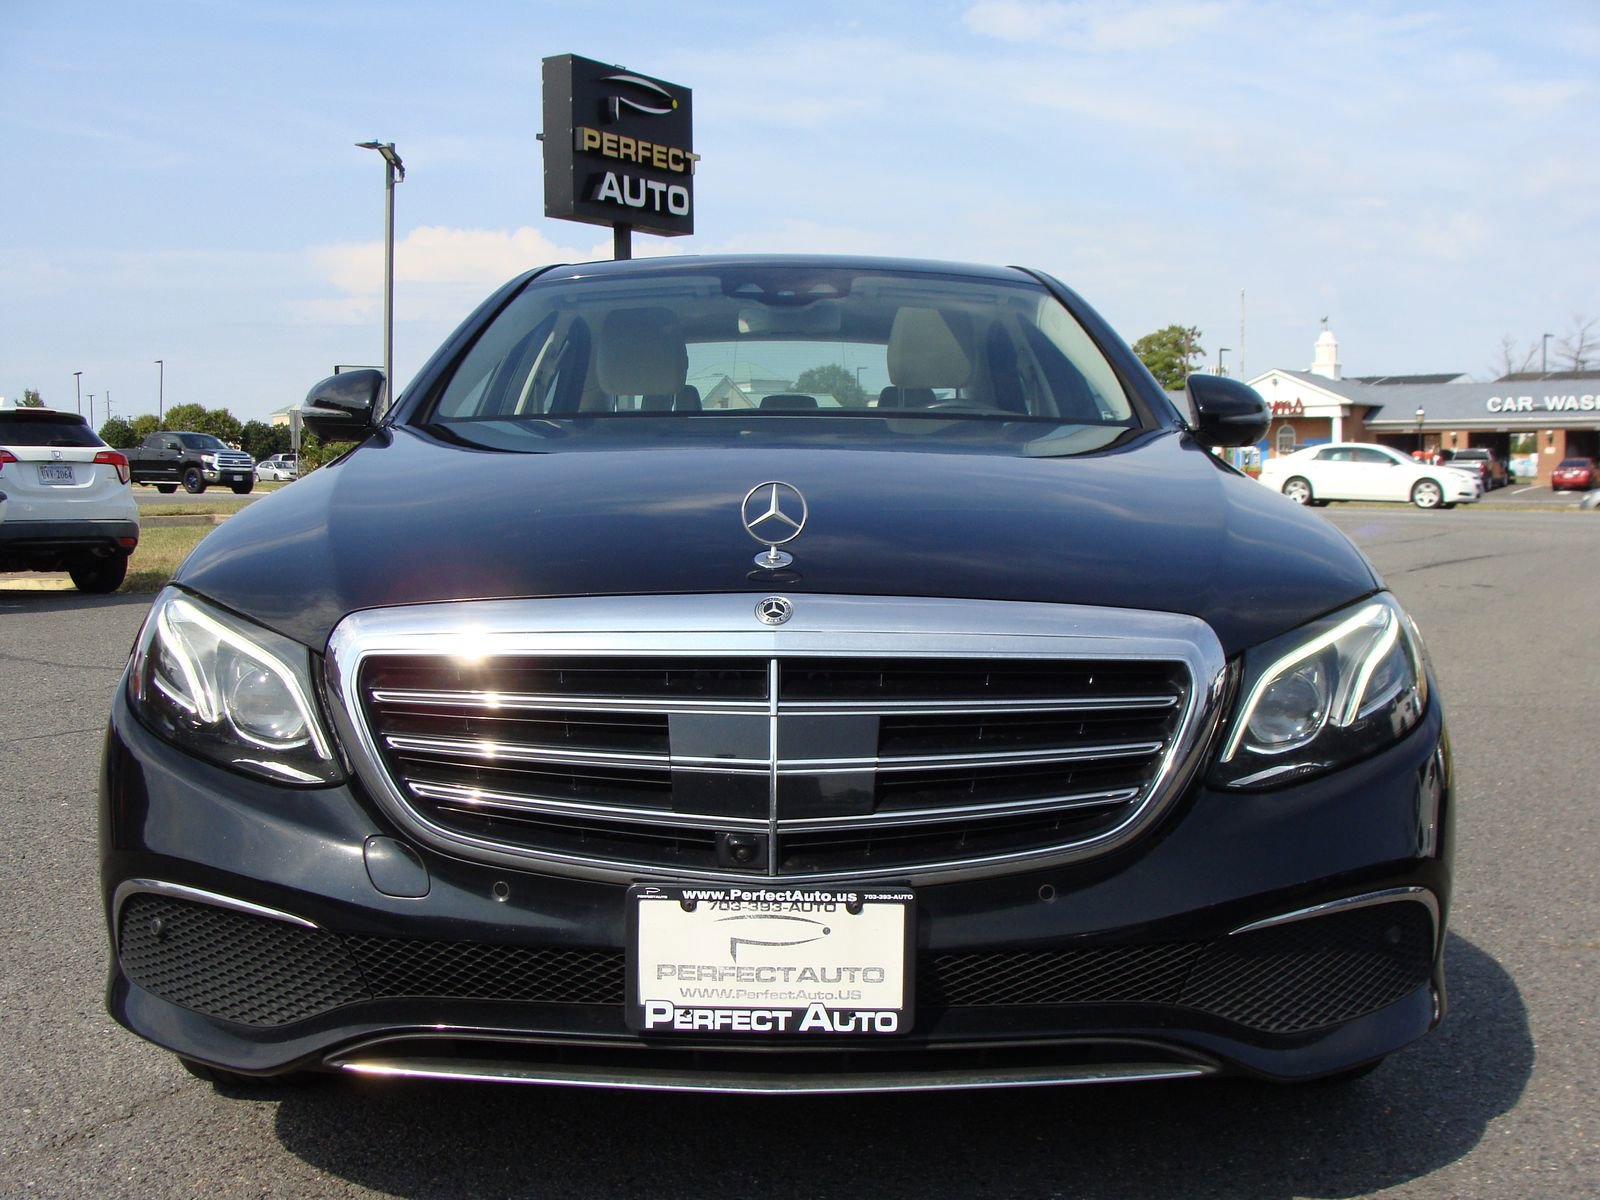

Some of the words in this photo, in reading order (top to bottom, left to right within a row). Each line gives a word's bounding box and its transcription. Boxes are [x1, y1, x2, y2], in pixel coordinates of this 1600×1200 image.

[583, 127, 700, 175] PERFECT
[597, 171, 689, 216] AUTO
[1486, 396, 1533, 412] CAR
[682, 889, 858, 902] www.PerfectAuto.us
[656, 964, 885, 983] PERFECTAUTO
[679, 987, 862, 1000] WWW.PerfectAuto.US
[645, 1000, 792, 1031] PERFECT
[799, 1003, 898, 1032] AUTO
